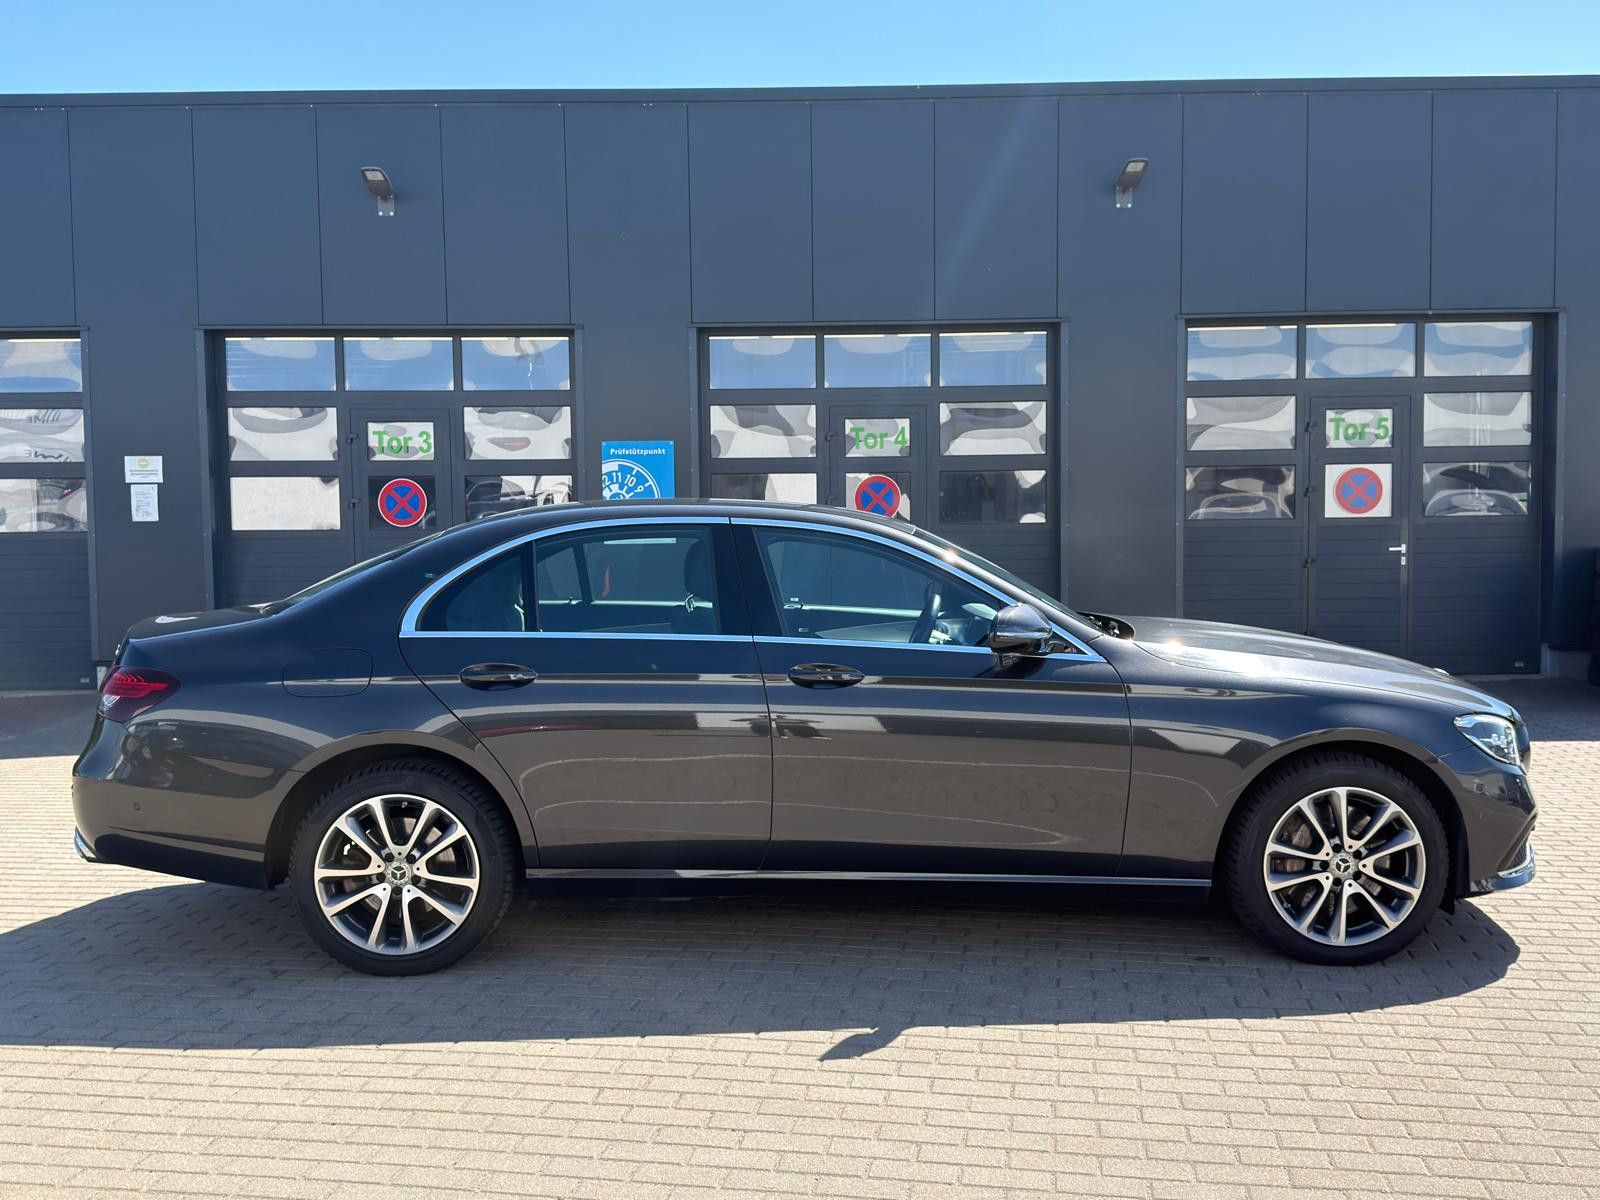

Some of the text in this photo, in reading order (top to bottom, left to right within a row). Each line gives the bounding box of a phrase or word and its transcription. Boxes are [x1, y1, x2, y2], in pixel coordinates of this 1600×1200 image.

[850, 426, 907, 449] Tor 4
[1328, 417, 1389, 440] Tor 5
[373, 430, 432, 454] Tor 3
[610, 448, 666, 456] Prüfstützpunkt
[612, 471, 622, 483] 11
[624, 474, 636, 487] 10
